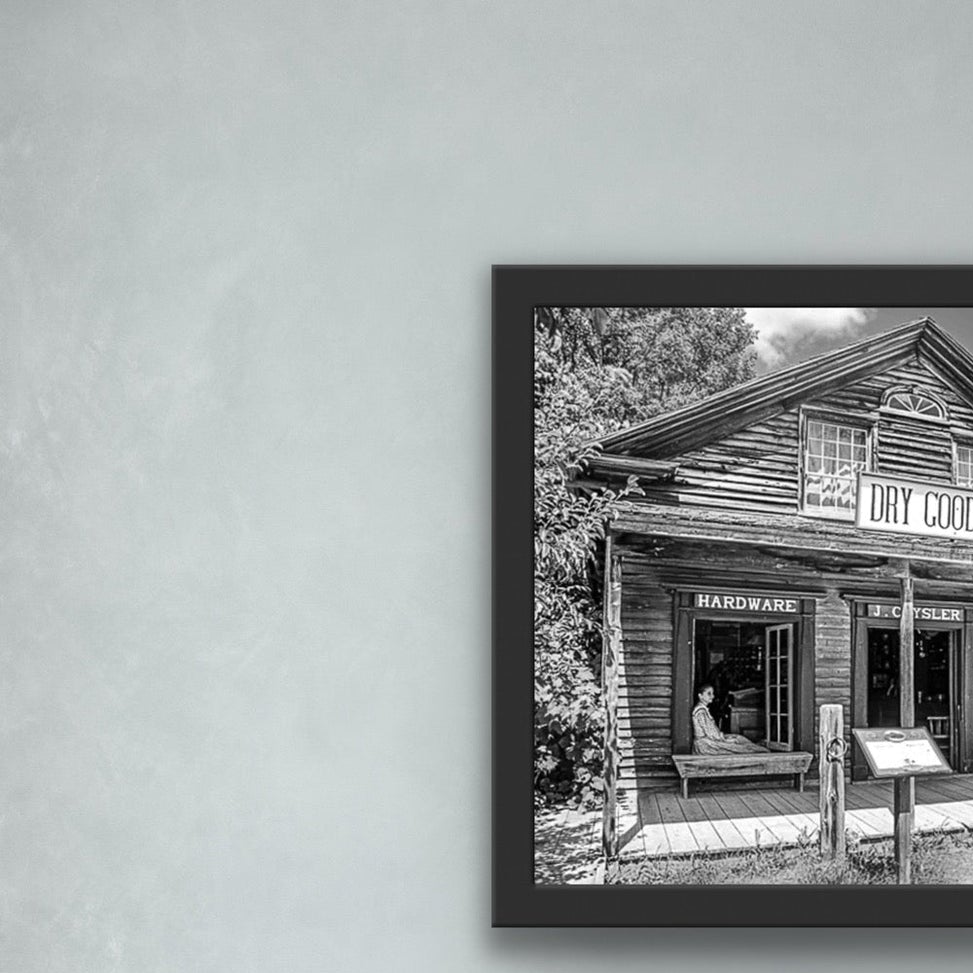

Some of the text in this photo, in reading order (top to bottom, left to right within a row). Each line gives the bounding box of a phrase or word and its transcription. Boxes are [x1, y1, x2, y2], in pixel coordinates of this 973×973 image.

[870, 483, 913, 525] DRY
[698, 594, 797, 612] HARDWARE
[873, 605, 960, 621] J. CYSLER
